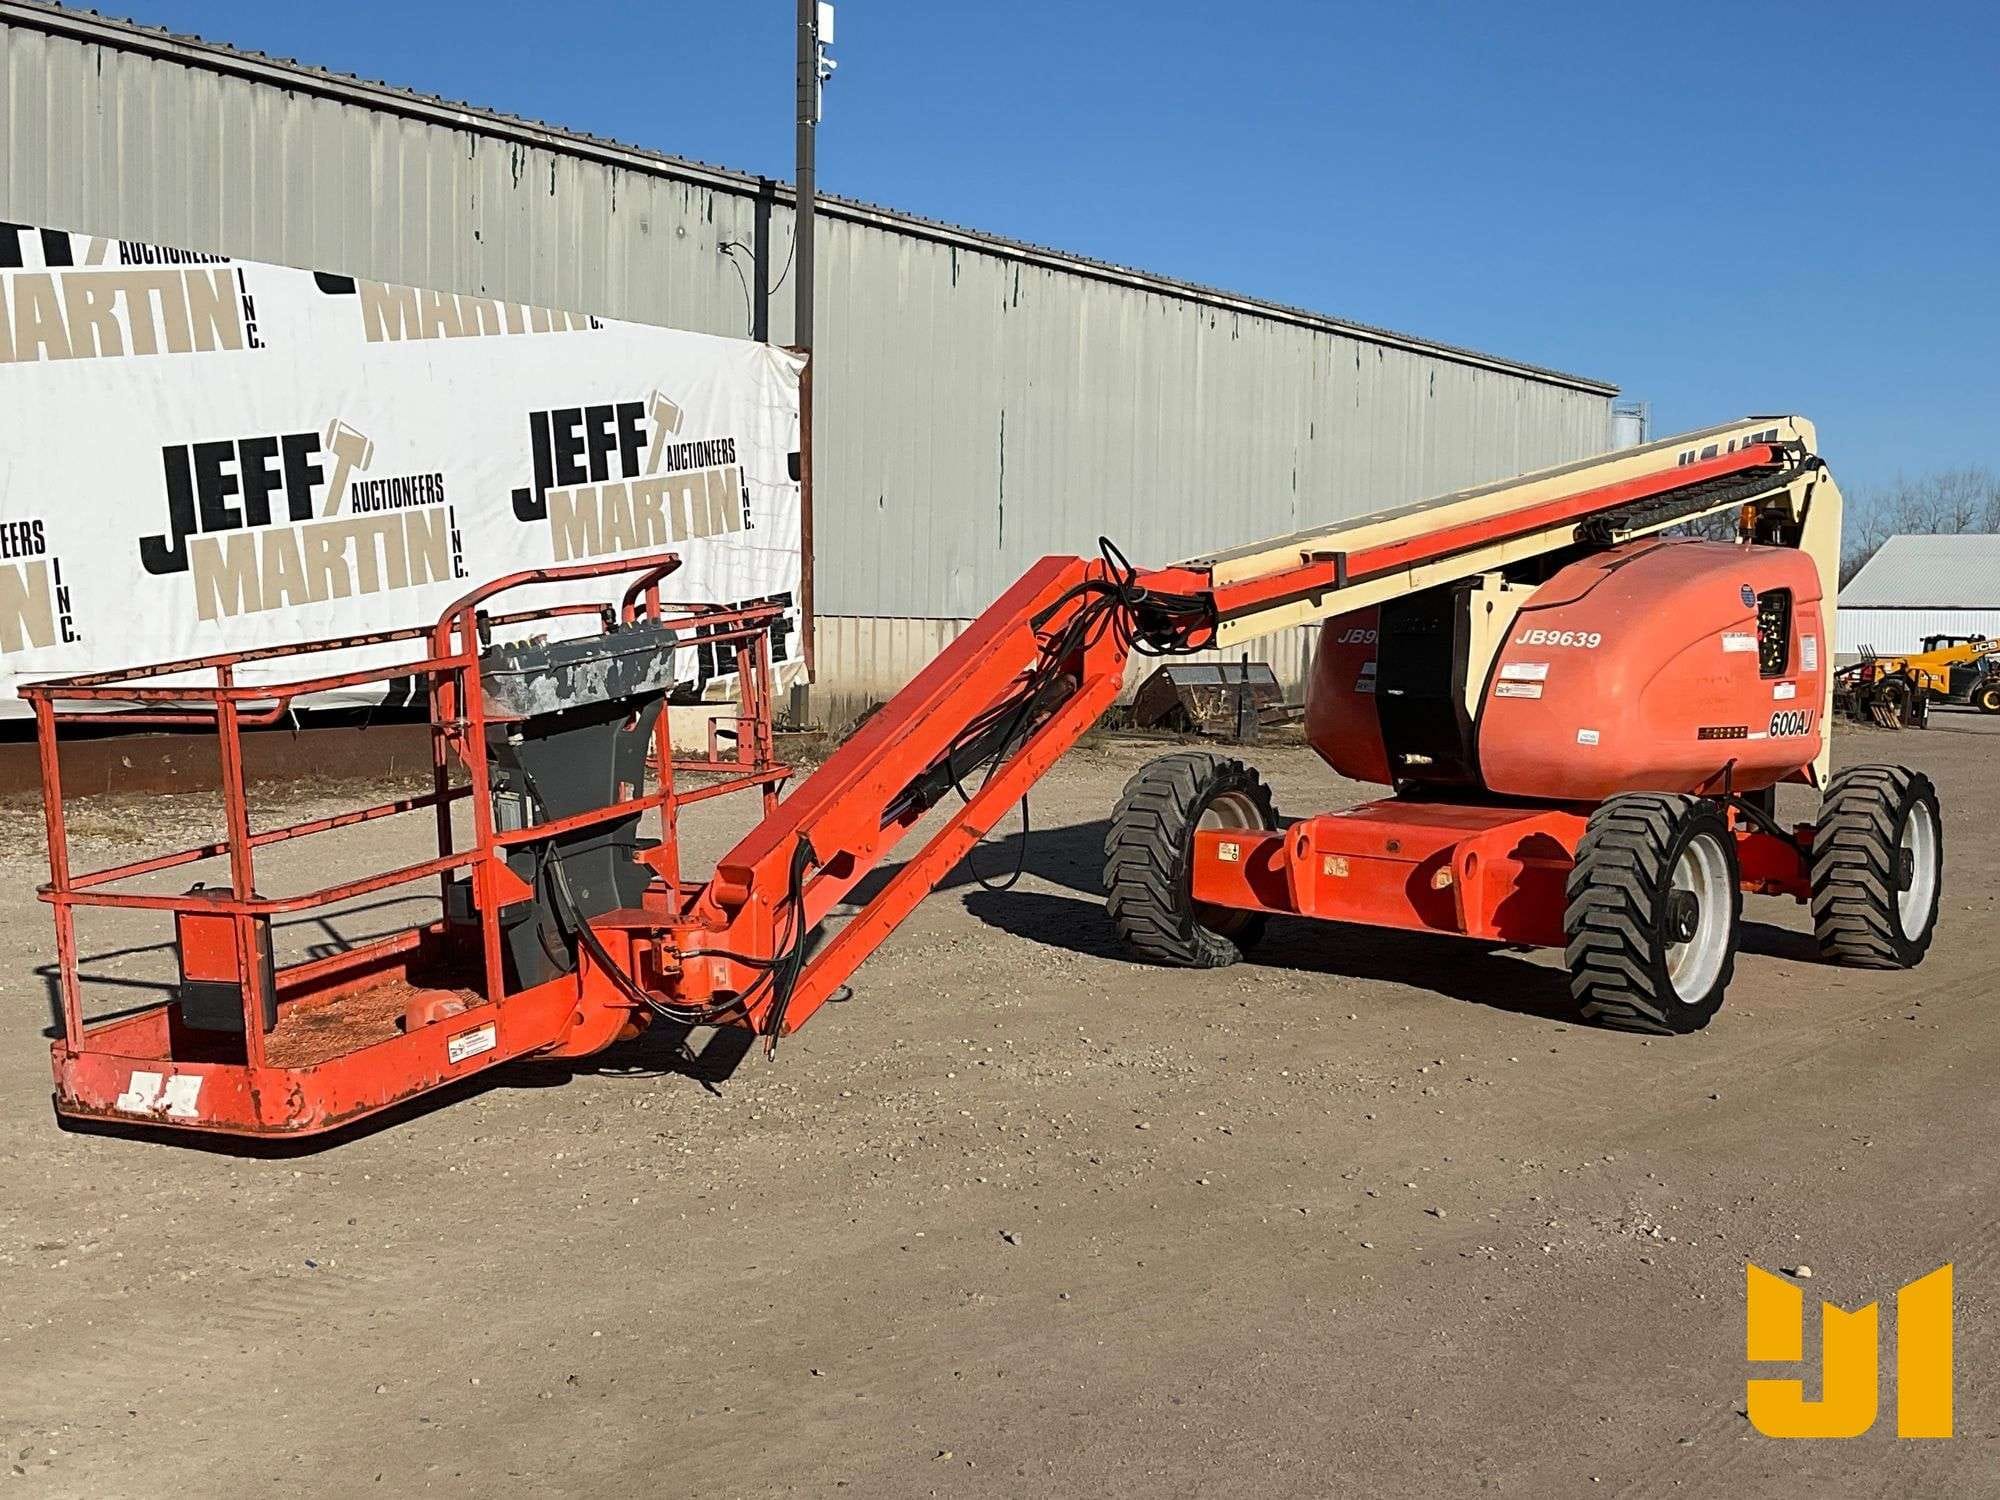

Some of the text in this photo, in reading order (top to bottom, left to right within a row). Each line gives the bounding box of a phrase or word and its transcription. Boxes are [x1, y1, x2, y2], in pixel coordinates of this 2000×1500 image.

[0, 268, 244, 362] ARTIN
[512, 402, 648, 522] JEFF
[667, 438, 736, 472] AUCTIONEERS
[139, 432, 324, 575] JEFF
[352, 473, 444, 513] AUCTIONEERS
[548, 467, 741, 562] MARTIN
[0, 519, 46, 559] EERS
[190, 507, 450, 621] MARTIN
[1337, 628, 1379, 645] JB9
[1515, 629, 1602, 649] JB9639
[1770, 709, 1814, 738] 600AJ
